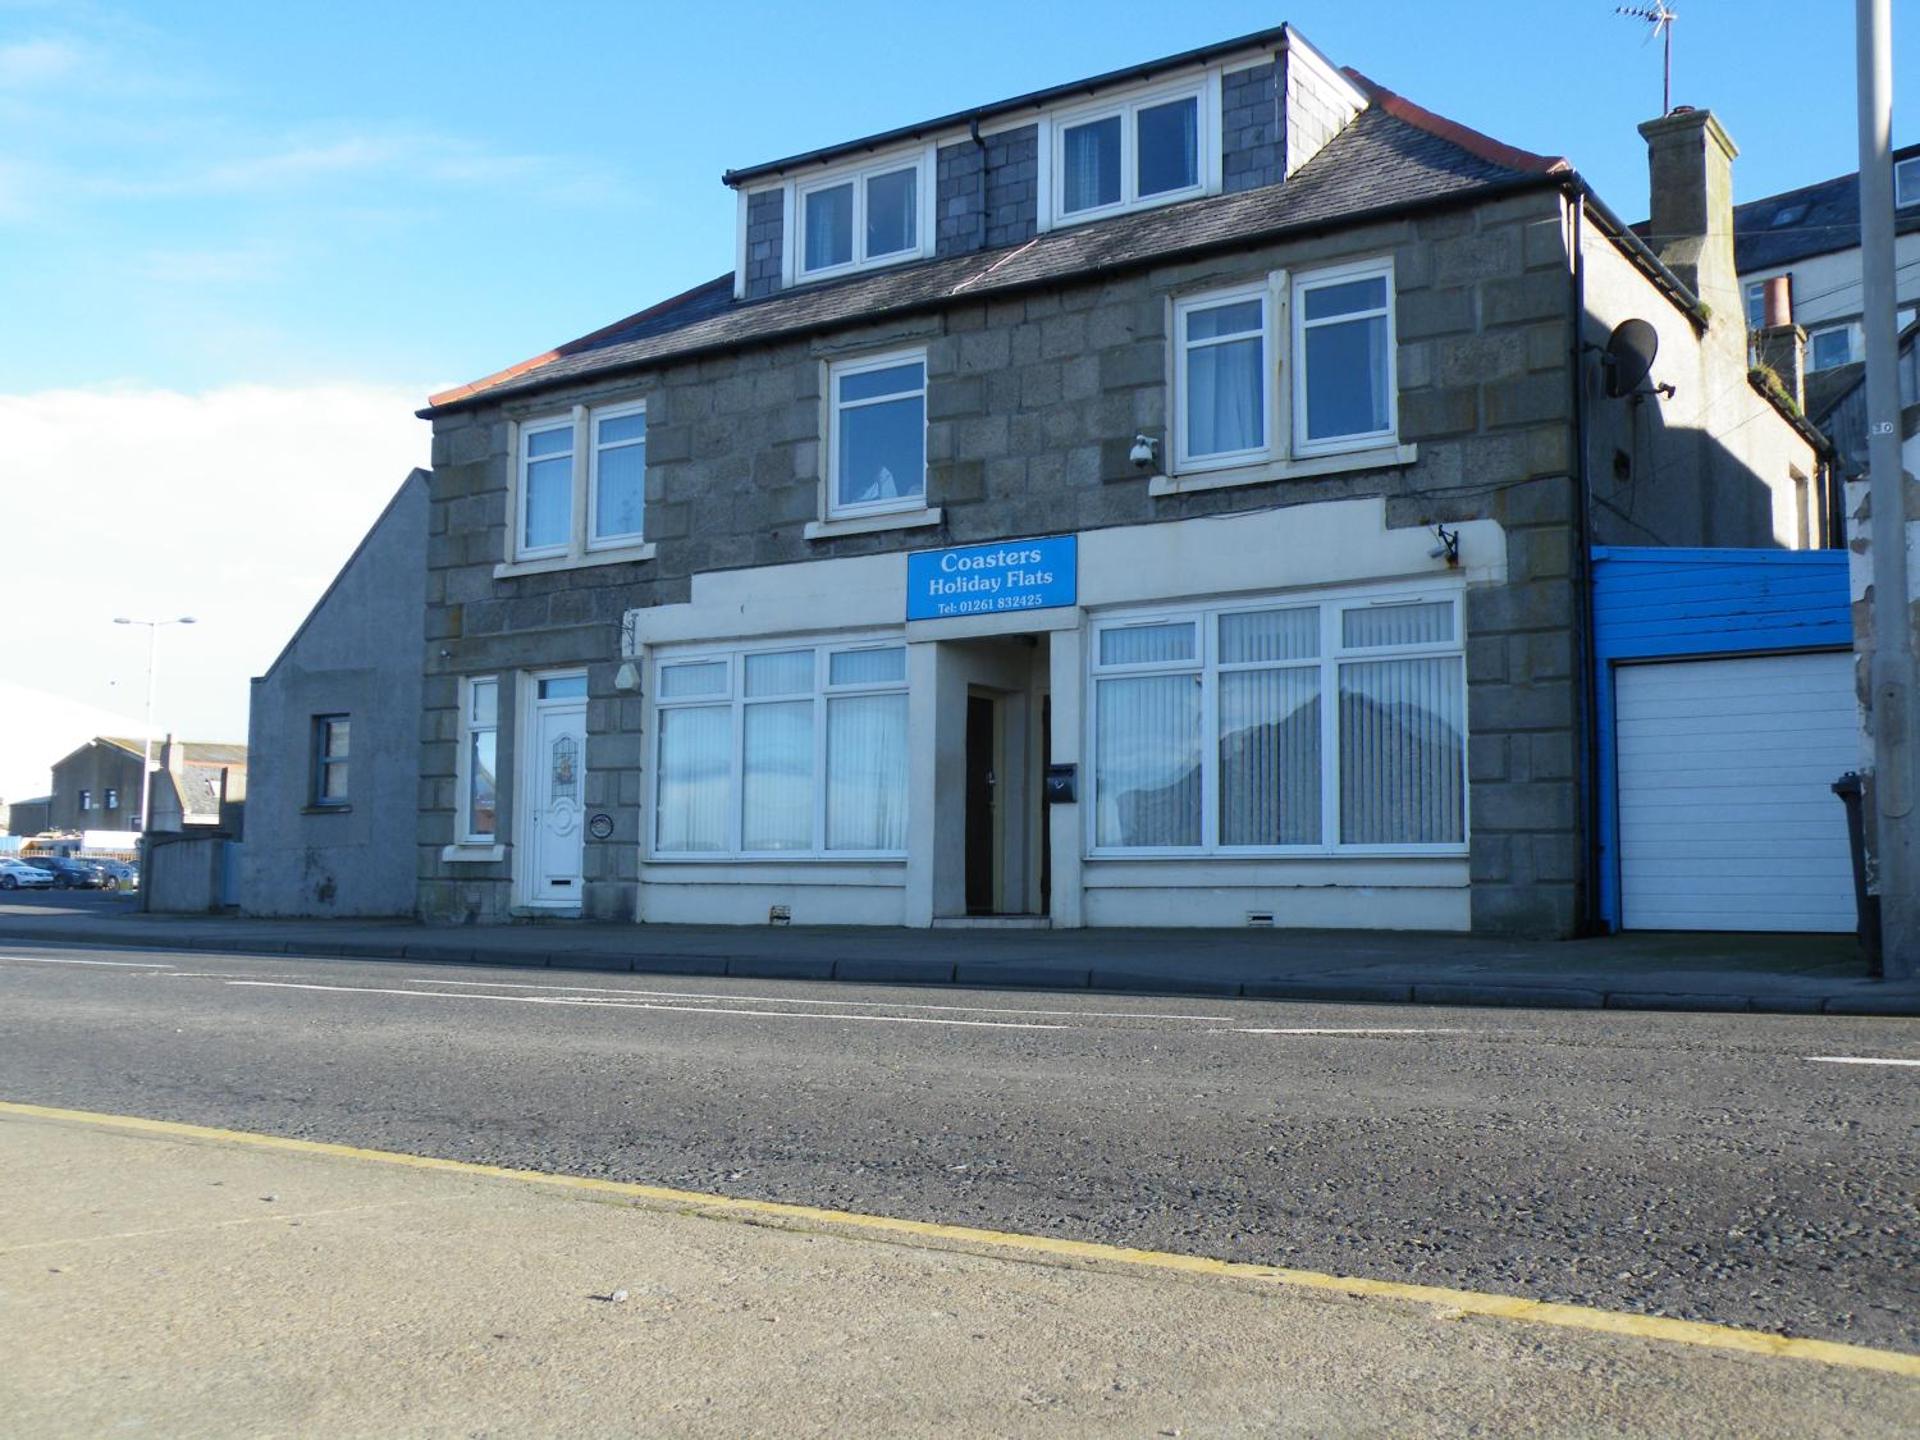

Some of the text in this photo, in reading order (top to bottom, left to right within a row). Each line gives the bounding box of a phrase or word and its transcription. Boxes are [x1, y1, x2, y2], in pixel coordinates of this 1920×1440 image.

[941, 549, 1041, 572] Coasters
[929, 570, 1053, 595] Holiday Flats
[938, 593, 1042, 615] Tel: 01261 832425
